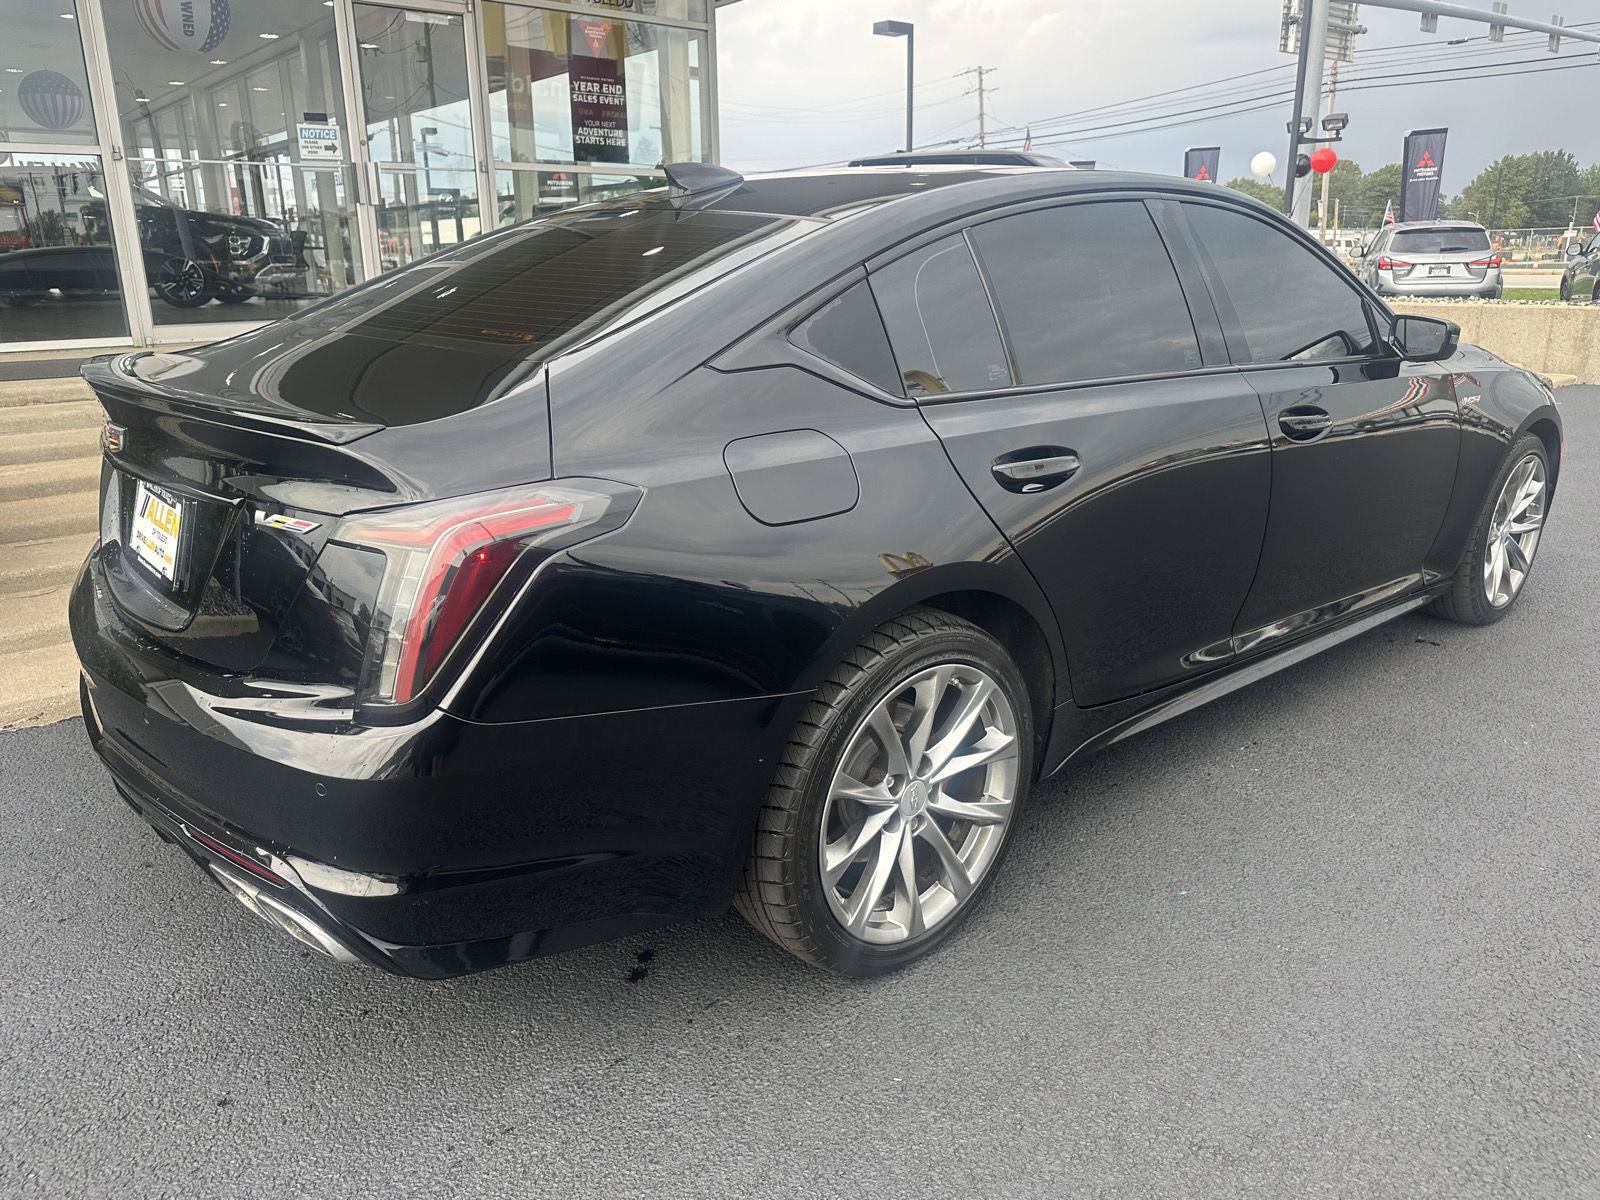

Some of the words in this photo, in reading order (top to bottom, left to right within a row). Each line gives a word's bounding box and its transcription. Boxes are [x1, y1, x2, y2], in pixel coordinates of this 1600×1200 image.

[587, 0, 634, 8] EDO
[573, 81, 600, 93] YEAR
[602, 83, 623, 94] END
[572, 94, 598, 104] SALES
[599, 96, 624, 106] EVENT
[583, 119, 600, 127] YOUR
[301, 129, 335, 139] NOTICE
[577, 127, 624, 138] ADVENTURE
[575, 135, 605, 145] STARTS
[606, 138, 626, 147] HERE
[147, 499, 180, 538] ALLEN
